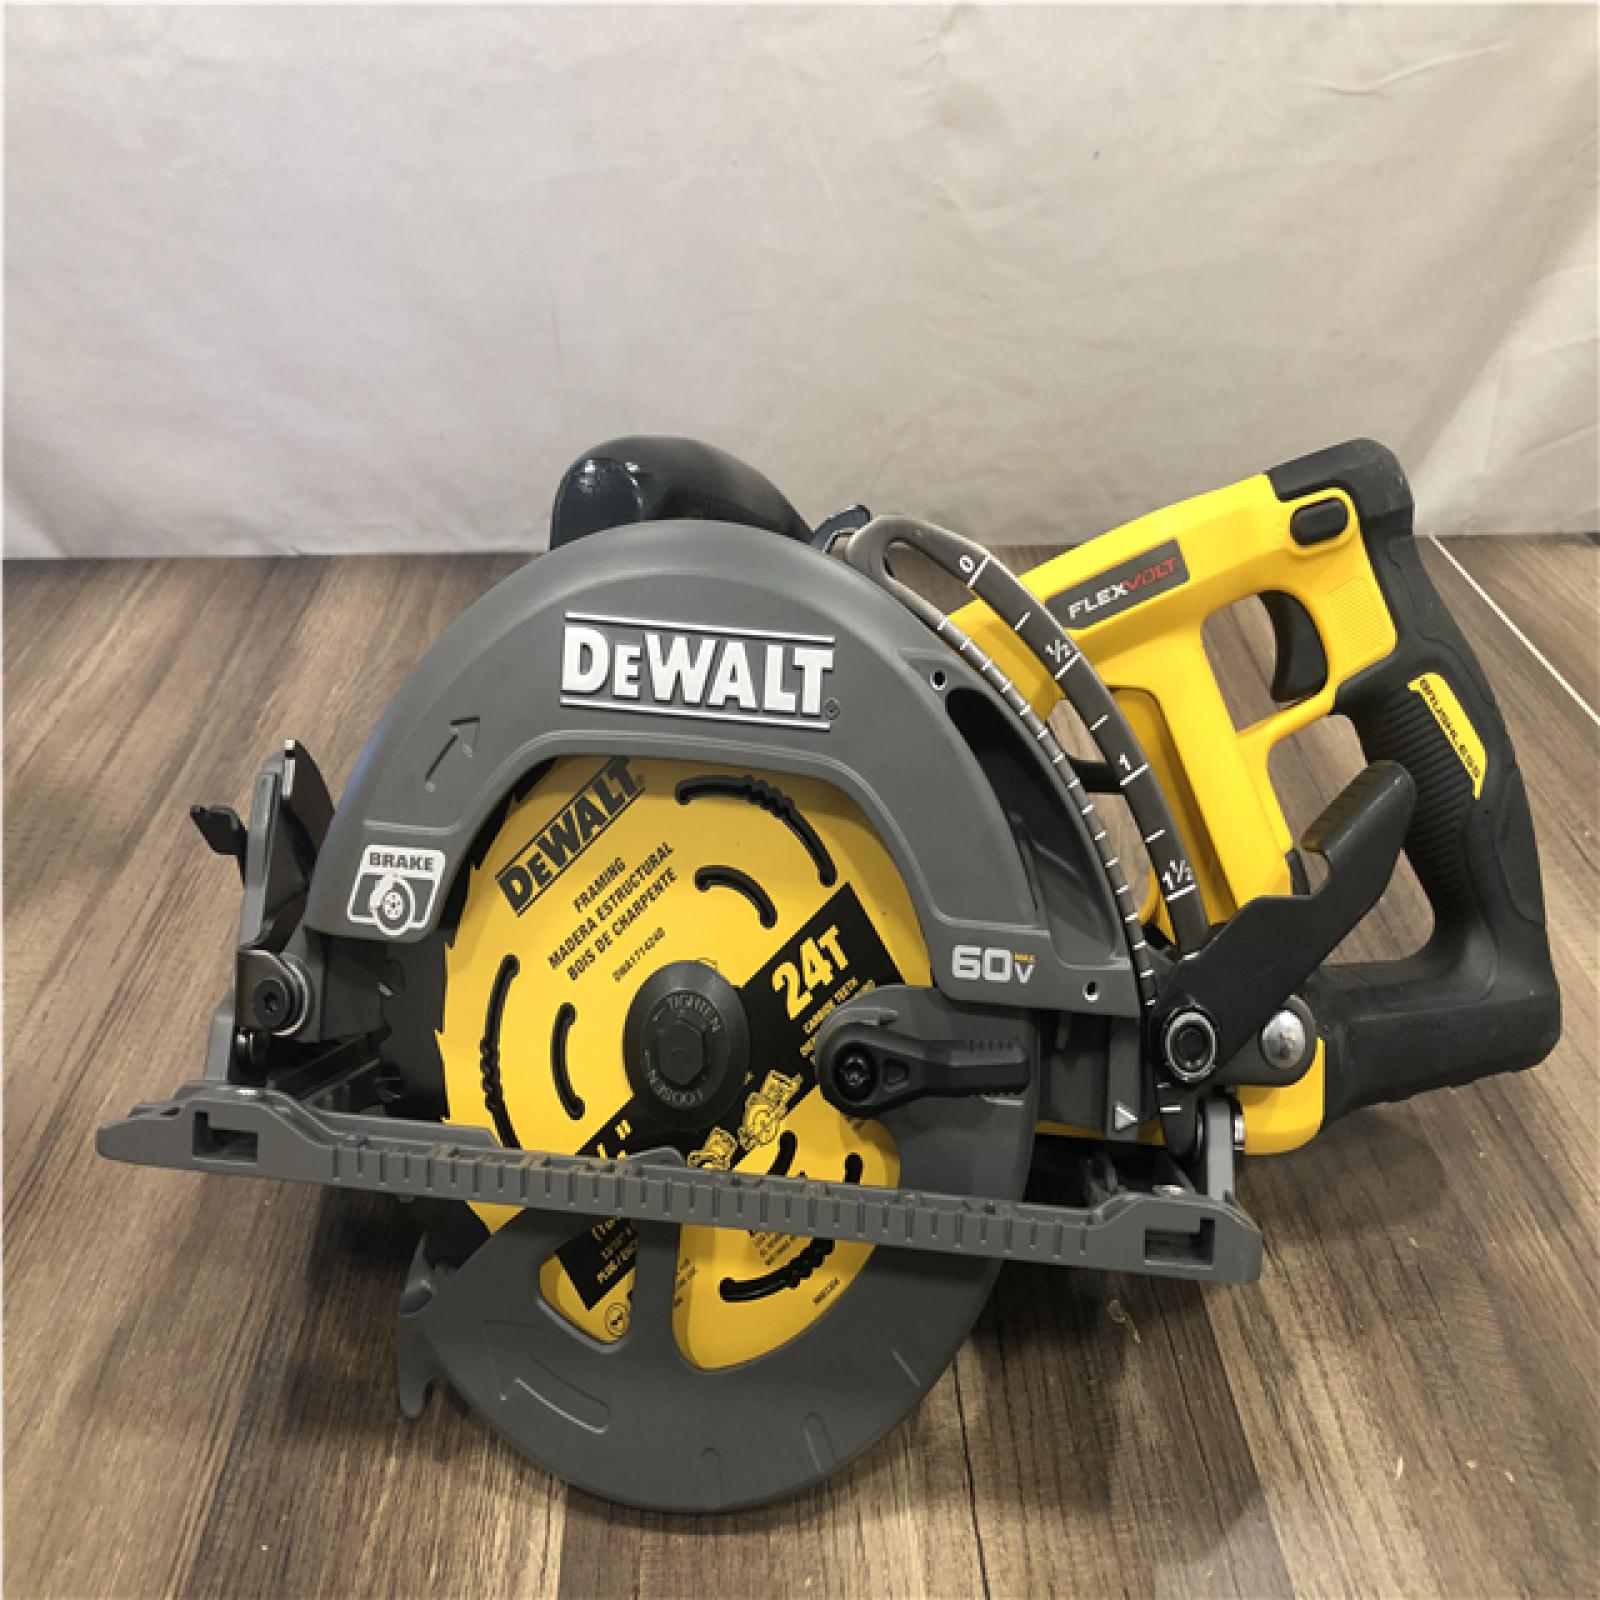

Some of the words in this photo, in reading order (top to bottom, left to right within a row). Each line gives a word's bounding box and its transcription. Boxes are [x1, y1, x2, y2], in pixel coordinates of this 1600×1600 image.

[959, 555, 976, 574] 0
[1067, 556, 1177, 621] FLEXVOLT
[1119, 753, 1132, 772] 1
[369, 852, 435, 872] BRAKE
[573, 857, 626, 912] FRAMING
[547, 916, 598, 969] MADERA
[596, 841, 675, 921] ESTRUCTURAL
[566, 948, 597, 984] BOIS
[594, 930, 613, 953] DE
[612, 866, 677, 936] CHARPENTE
[772, 924, 849, 1020] 24T
